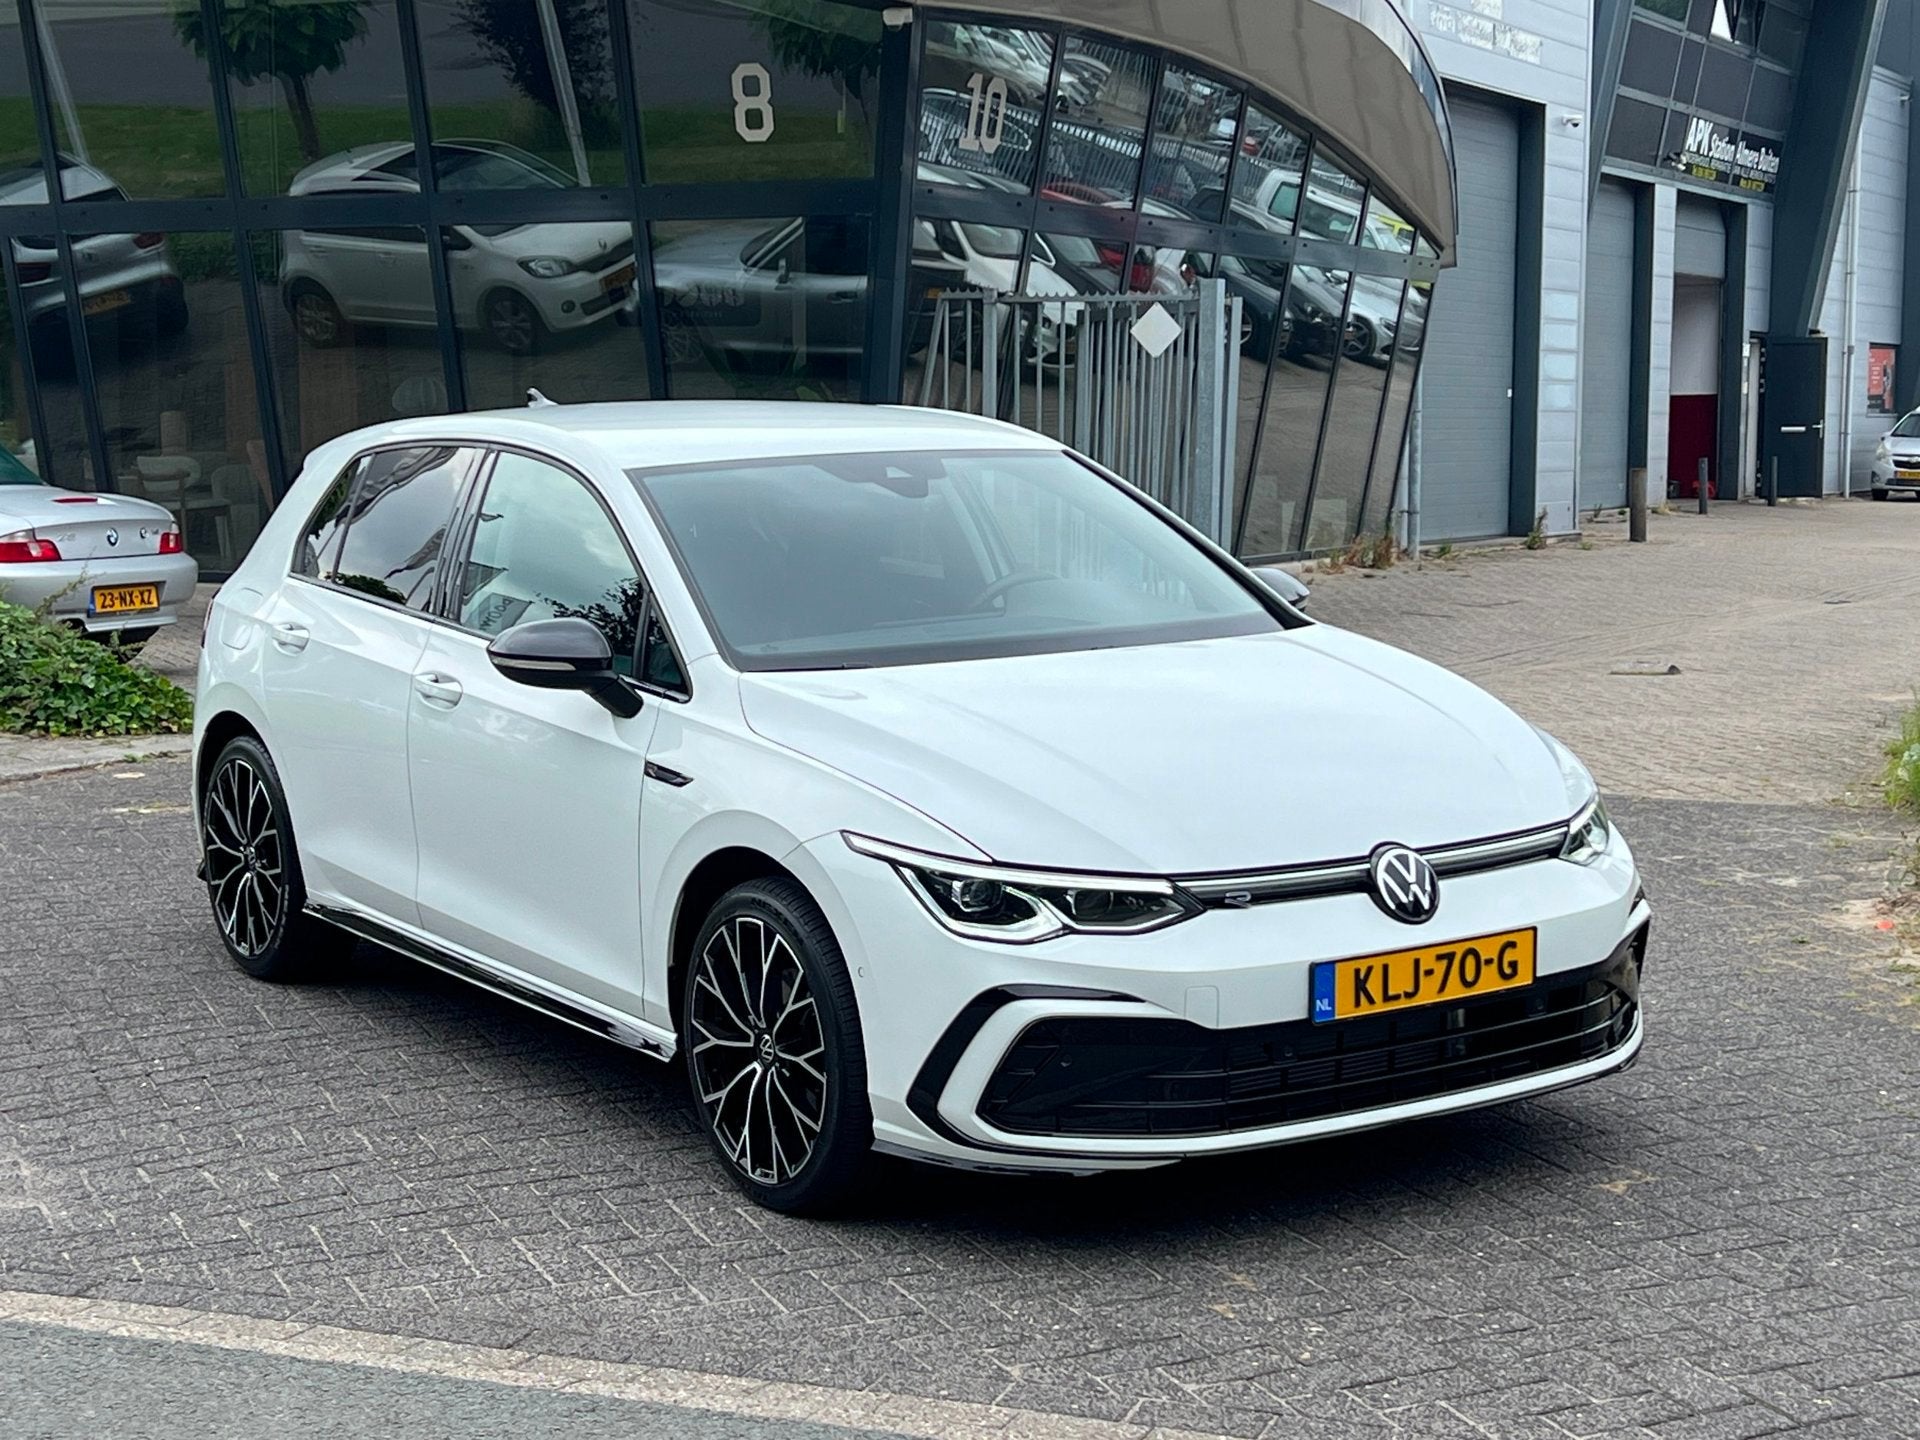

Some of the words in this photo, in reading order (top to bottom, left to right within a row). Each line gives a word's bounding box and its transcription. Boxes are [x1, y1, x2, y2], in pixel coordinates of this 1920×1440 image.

[731, 62, 775, 142] 8
[958, 72, 1008, 154] 10
[1685, 117, 1714, 156] APK
[1709, 133, 1736, 162] Station
[99, 588, 154, 609] 23-NX-XZ
[1353, 940, 1519, 1008] KLJ-70-G
[1315, 998, 1333, 1012] NL
